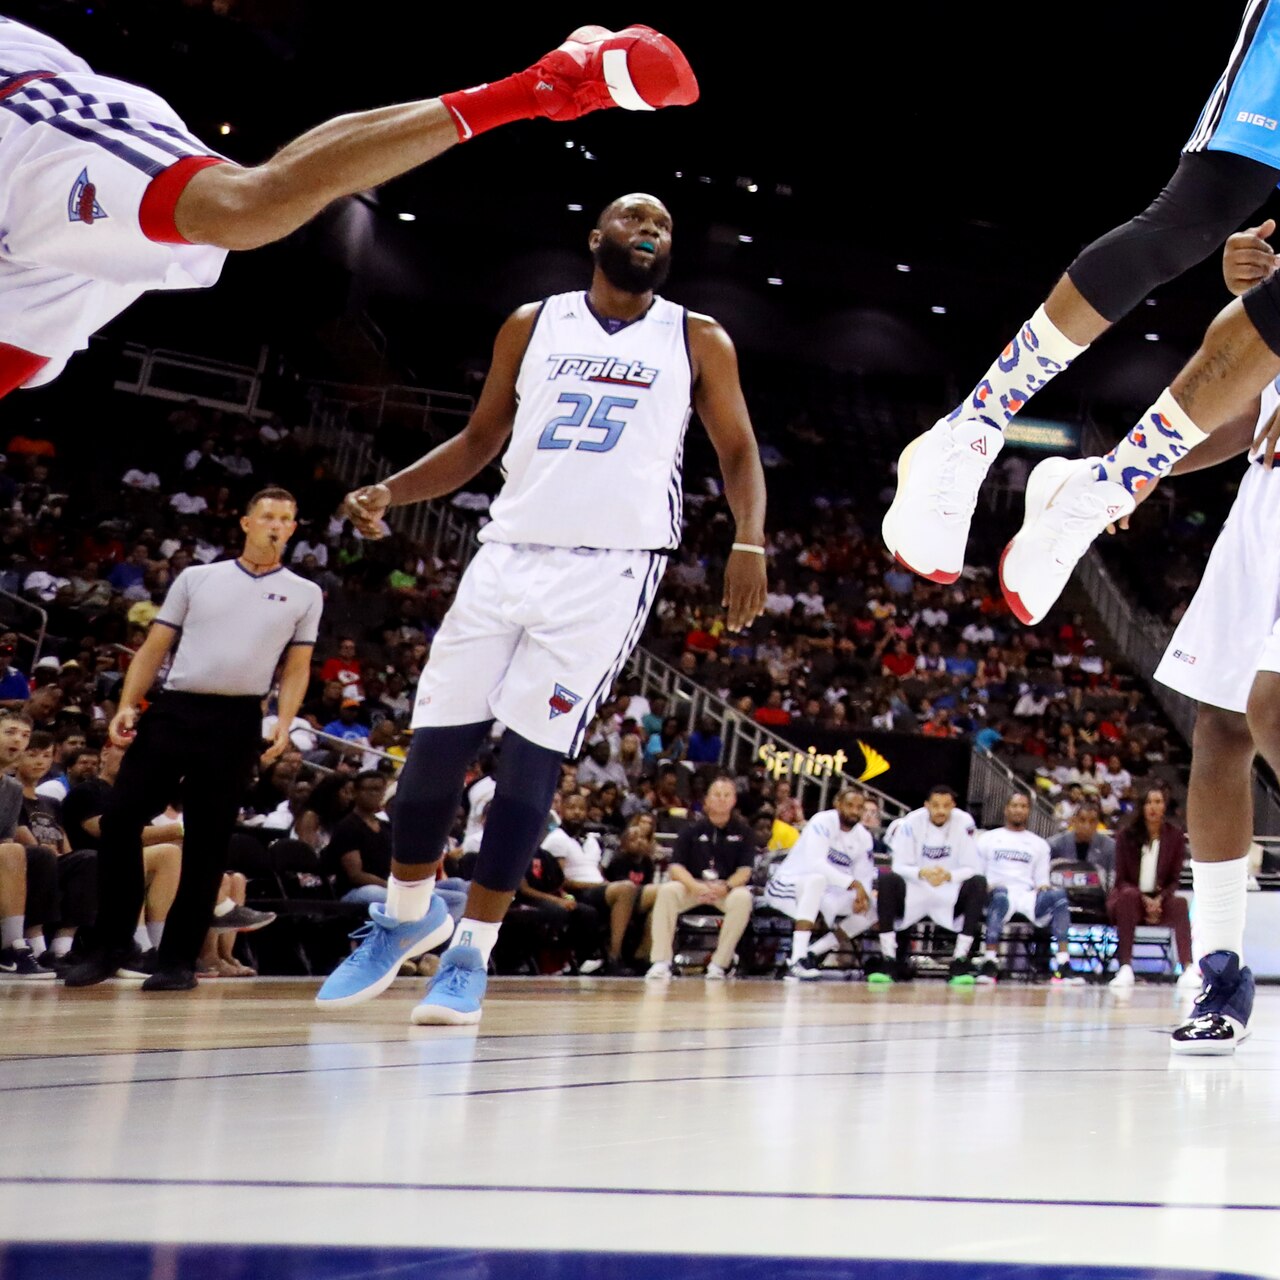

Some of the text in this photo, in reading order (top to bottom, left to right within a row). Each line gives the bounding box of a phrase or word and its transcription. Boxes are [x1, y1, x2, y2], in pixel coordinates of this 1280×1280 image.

[1236, 111, 1278, 131] BIG3
[547, 353, 660, 389] Triplets
[537, 392, 638, 453] 25
[758, 742, 848, 781] Sprint
